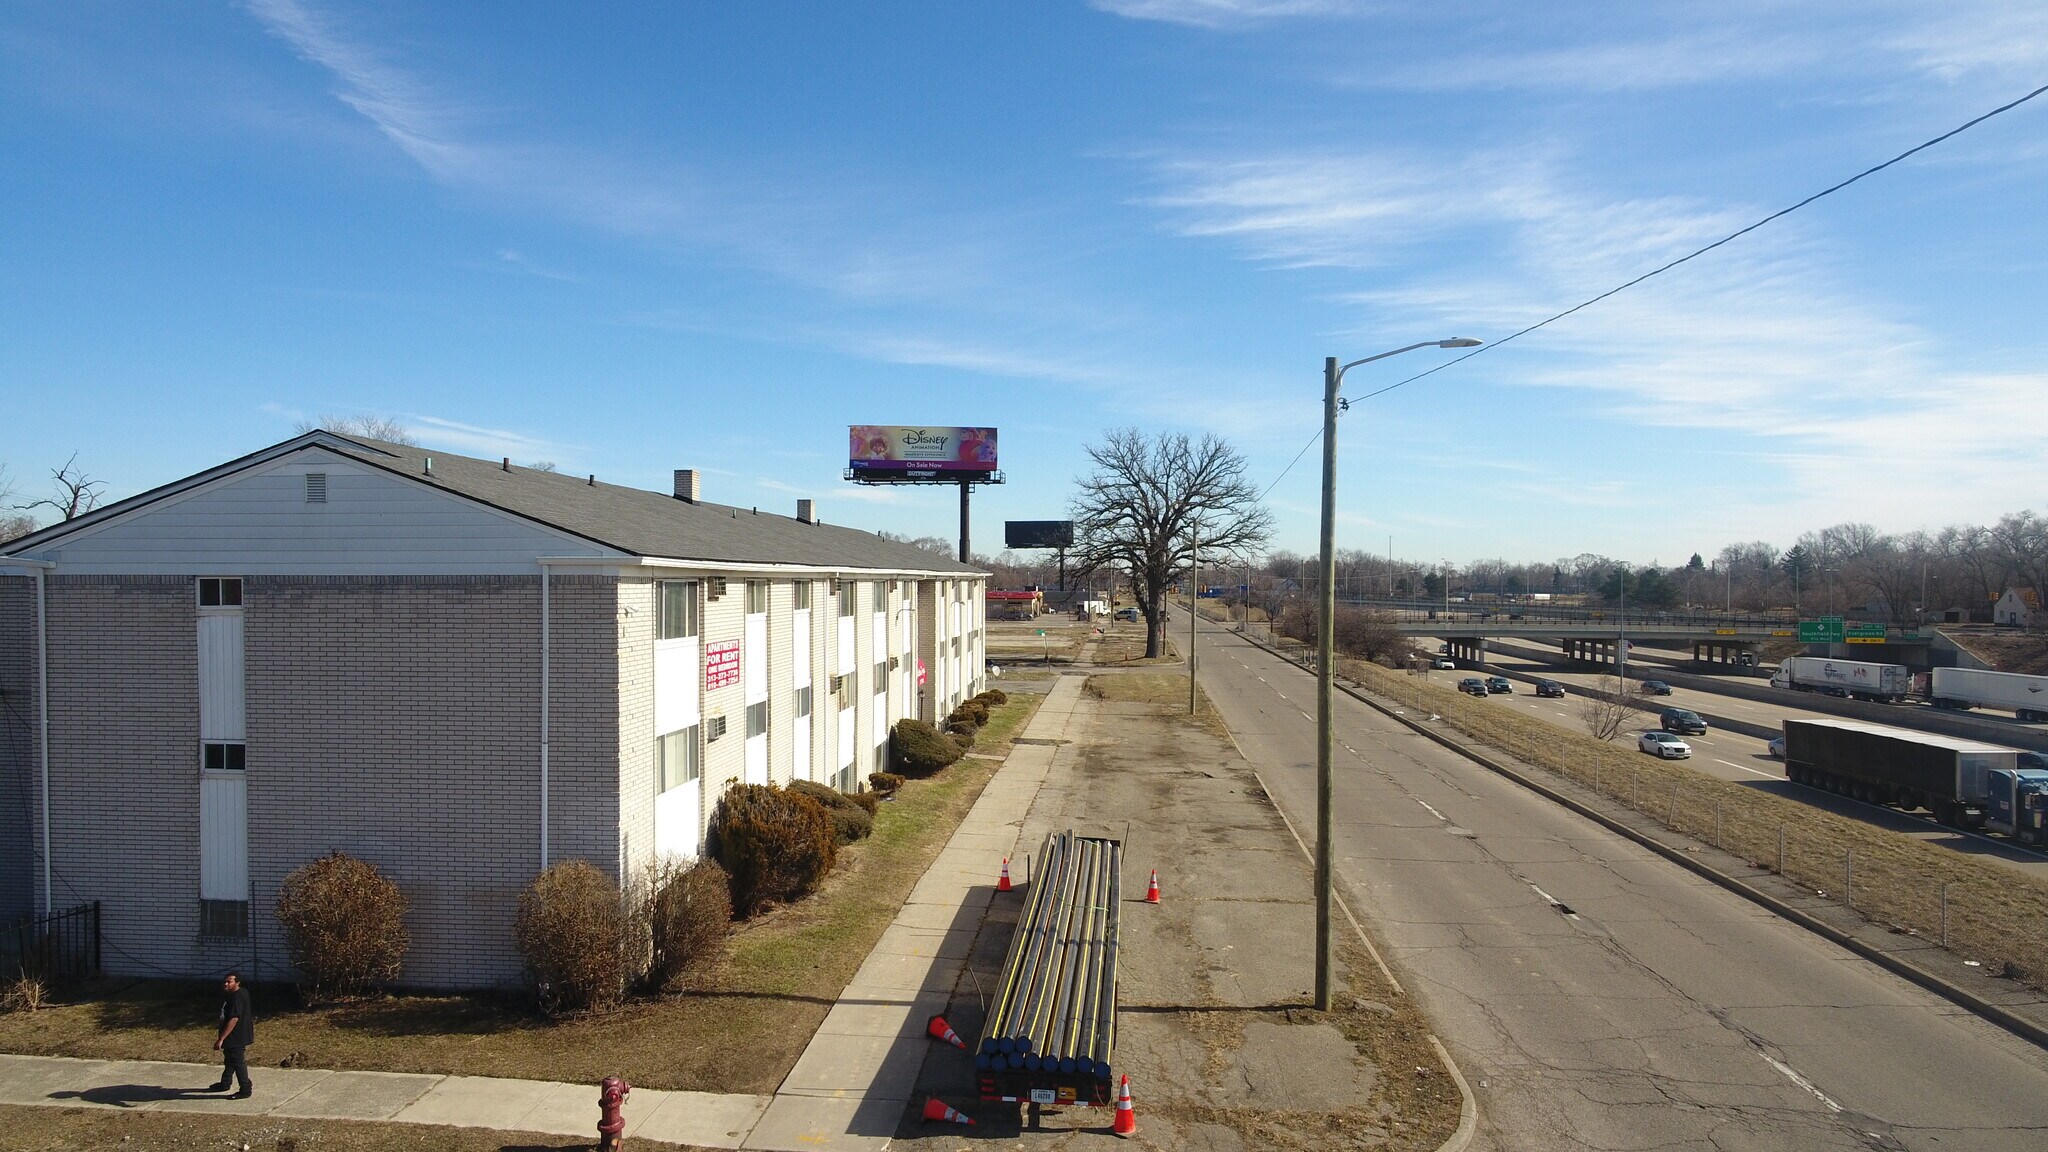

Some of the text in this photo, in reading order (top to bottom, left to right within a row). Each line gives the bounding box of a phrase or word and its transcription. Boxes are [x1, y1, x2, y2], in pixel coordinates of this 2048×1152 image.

[901, 428, 949, 450] Disney
[708, 640, 739, 654] APARTMENTS
[707, 651, 739, 666] FOR RENT
[708, 661, 738, 674] ONE BEDROOM
